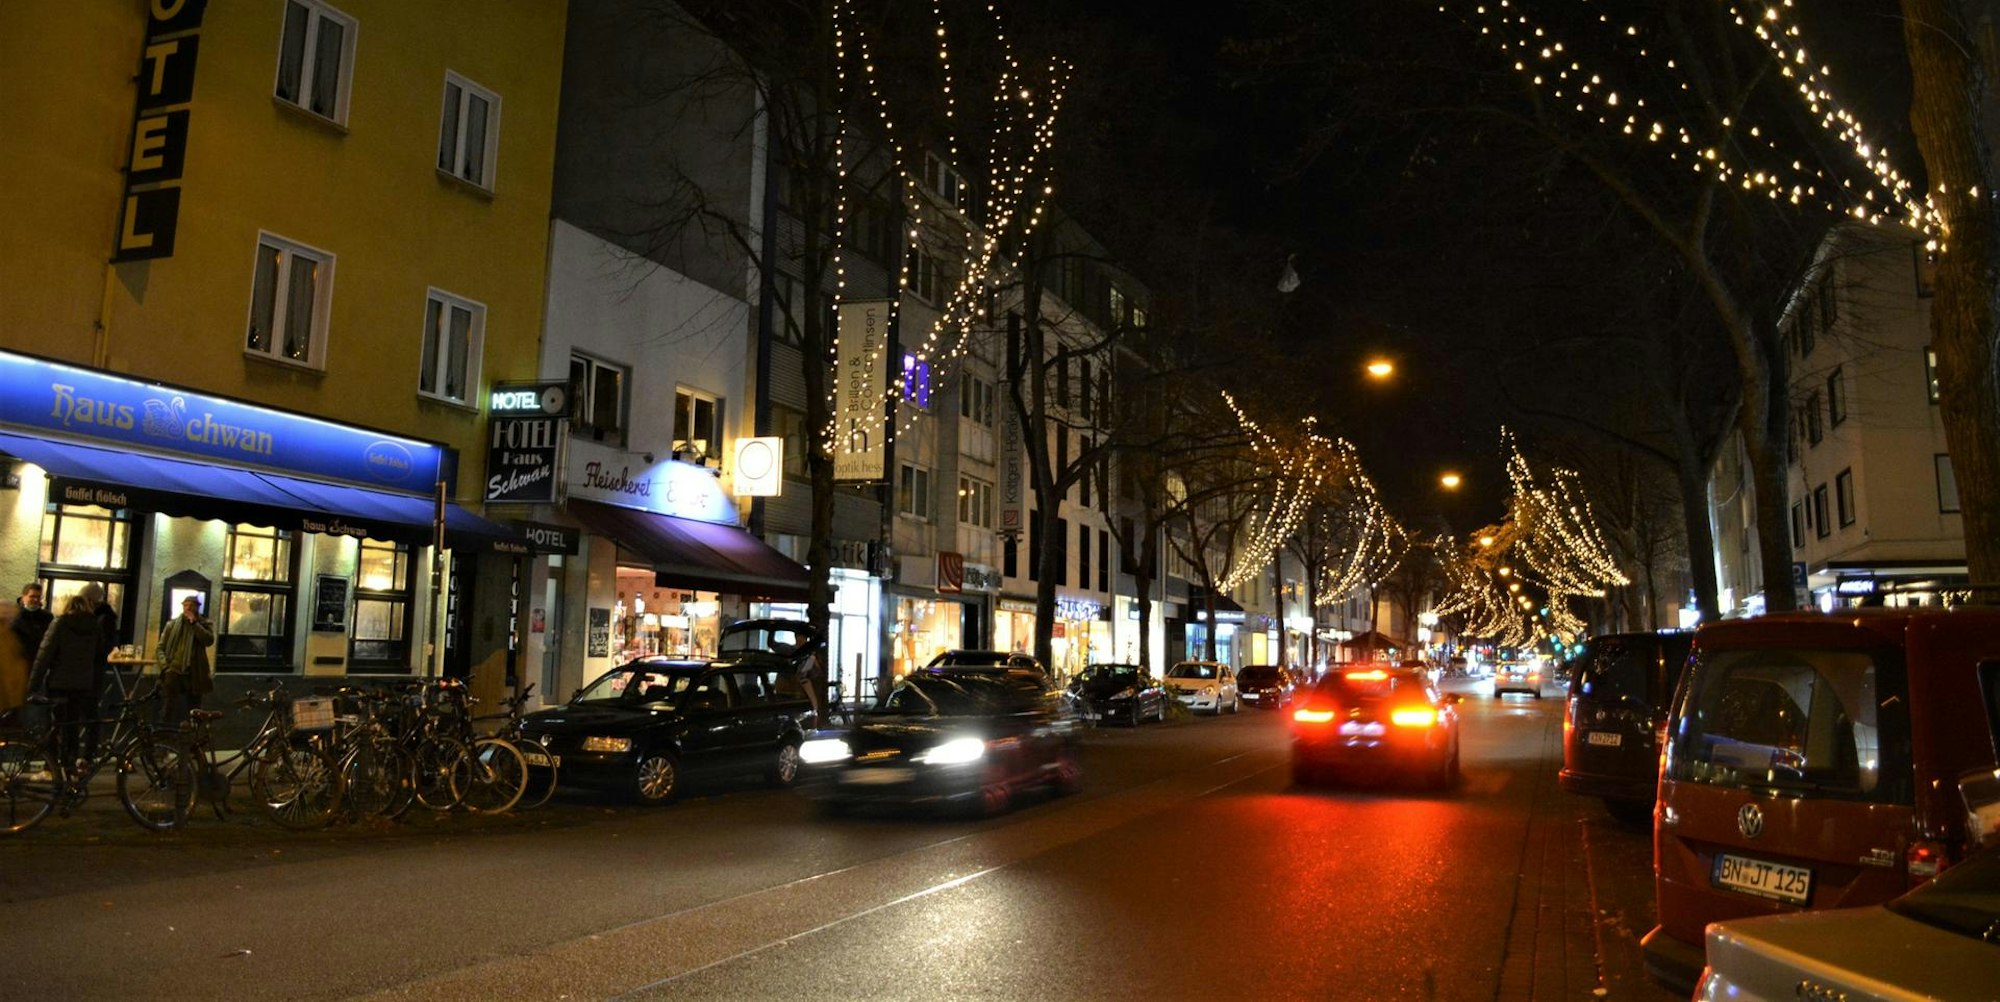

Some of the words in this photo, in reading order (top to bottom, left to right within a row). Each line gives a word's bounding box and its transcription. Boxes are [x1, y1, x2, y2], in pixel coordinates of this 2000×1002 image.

[849, 357, 861, 367] &
[52, 383, 135, 430] Haus
[492, 391, 541, 410] HOTEL
[848, 372, 861, 412] Brillen
[493, 420, 556, 450] HOTEL
[502, 452, 543, 465] Haus
[835, 460, 858, 474] optik
[862, 460, 882, 473] hess
[488, 464, 550, 499] Schwan
[582, 461, 651, 497] Fleischerei
[526, 528, 567, 548] HOTEL
[446, 557, 458, 648] HOTEL
[508, 563, 520, 650] HOTEL
[1721, 858, 1743, 881] BN
[1750, 863, 1773, 888] JT
[1774, 869, 1808, 894] 125
